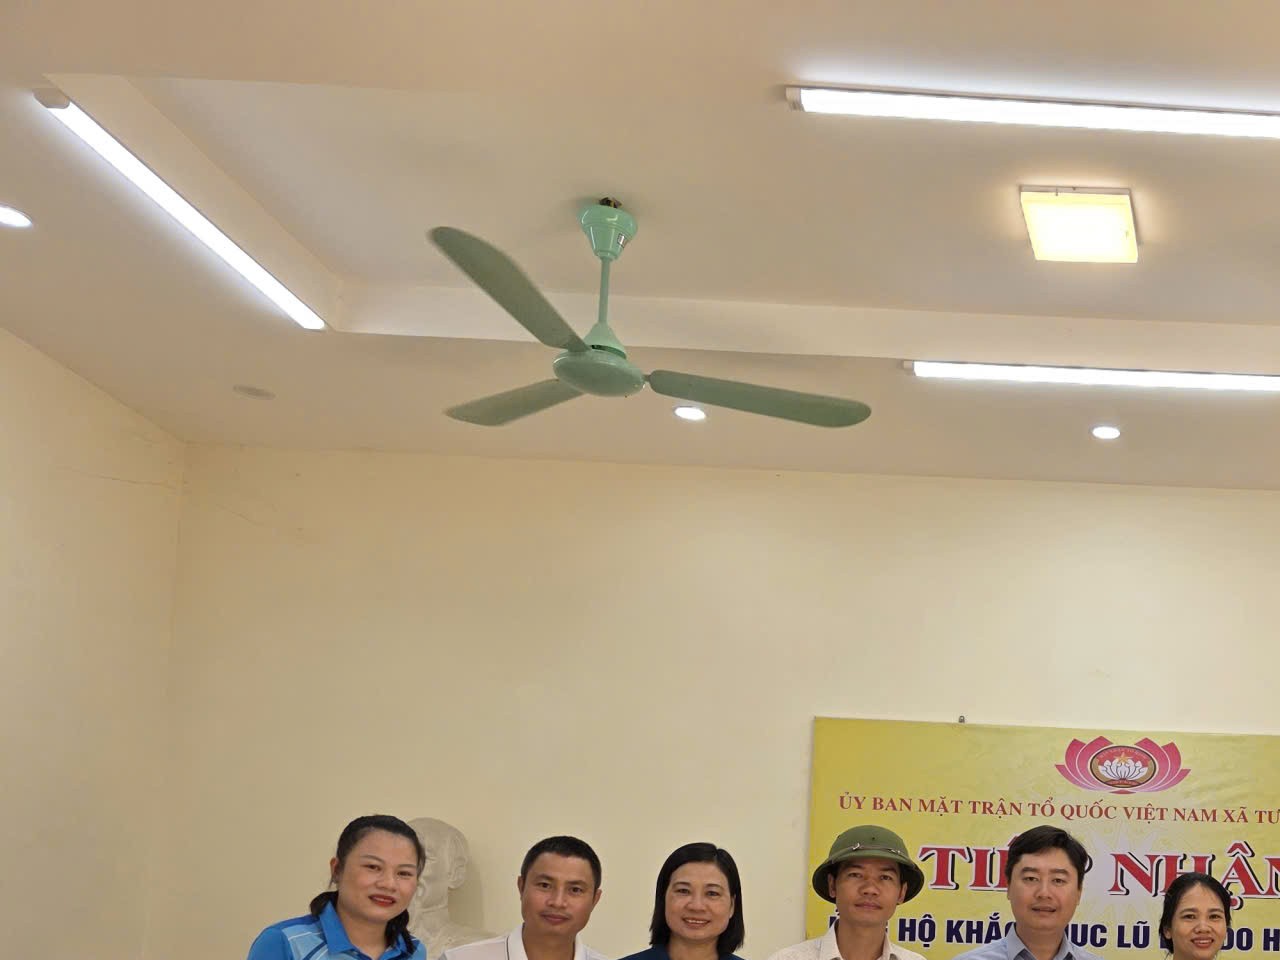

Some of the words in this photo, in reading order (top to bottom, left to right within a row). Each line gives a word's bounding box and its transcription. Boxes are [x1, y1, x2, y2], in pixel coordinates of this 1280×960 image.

[839, 791, 866, 810] ỦY
[873, 796, 912, 813] BAN
[918, 796, 963, 817] MẶT
[968, 799, 1023, 819] TRẬN
[1028, 796, 1056, 817] TỔ
[1060, 799, 1117, 820] QUỐC
[1123, 803, 1168, 825] VIỆT
[1173, 807, 1218, 823] NAM
[1223, 807, 1248, 823] XÃ
[898, 913, 936, 948] HỘ
[1117, 921, 1150, 949] LŨ
